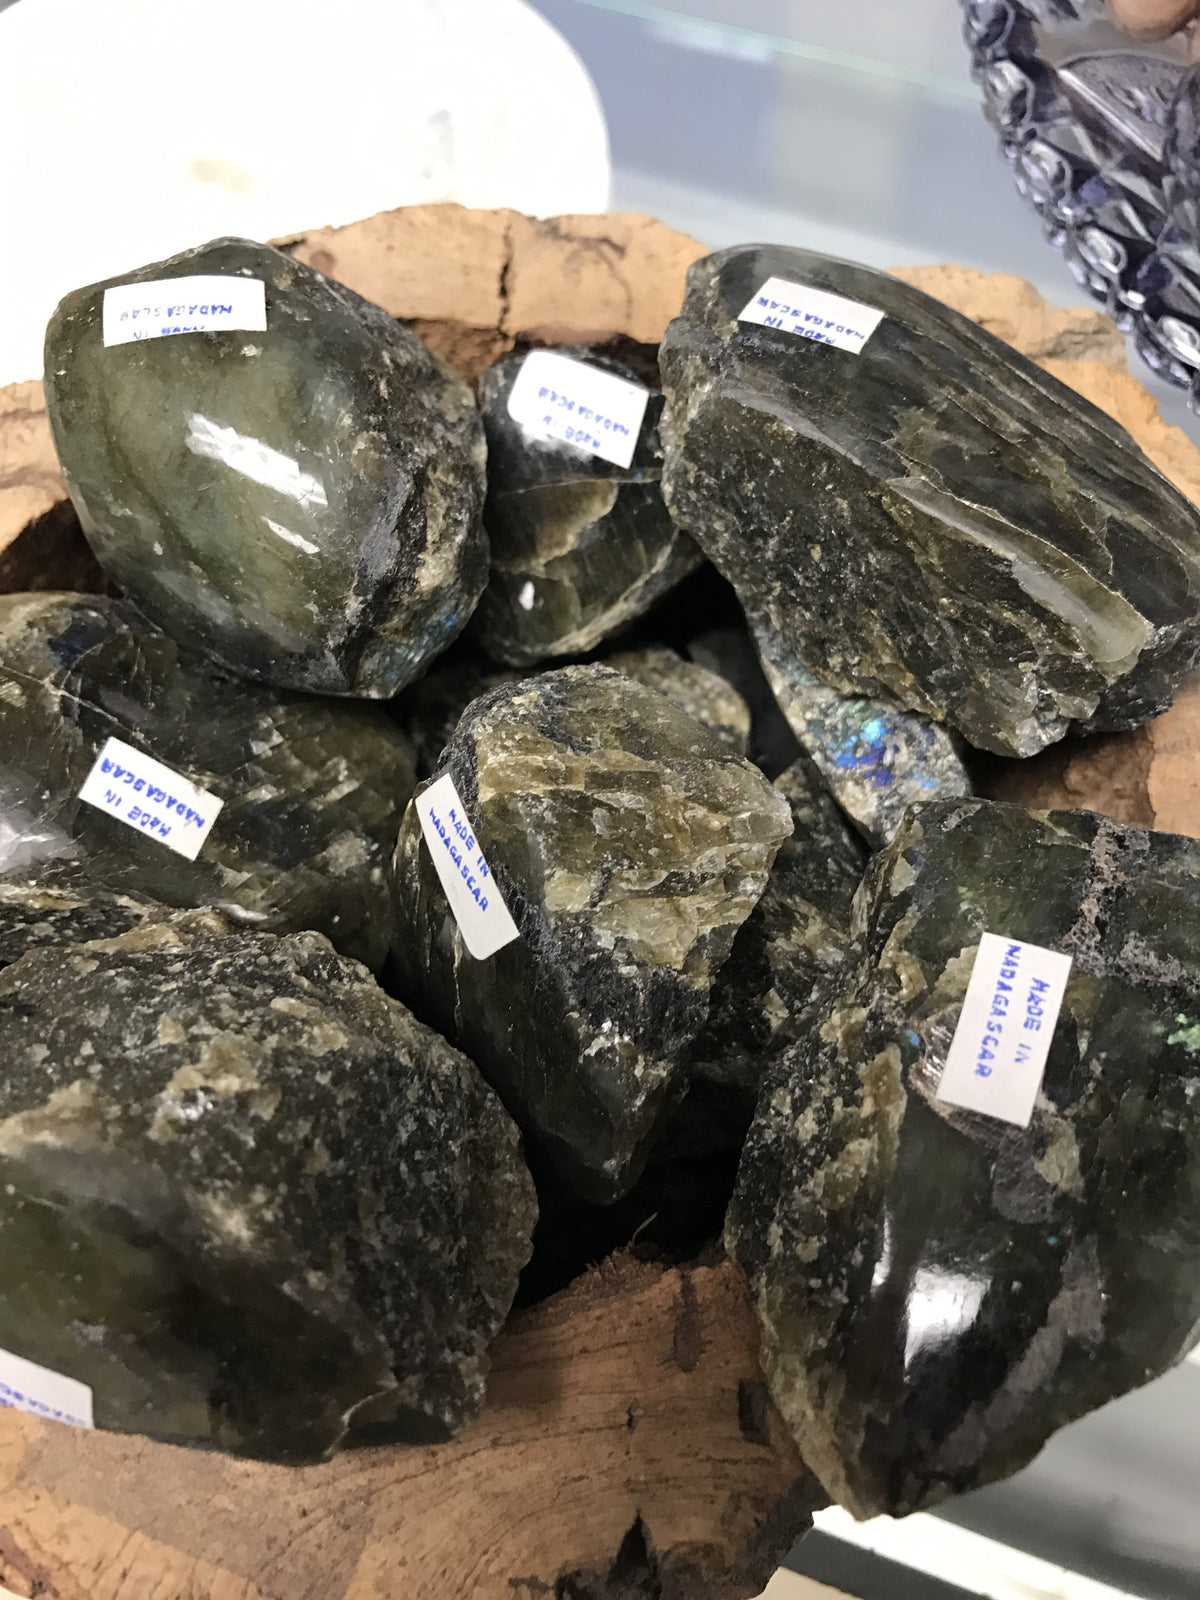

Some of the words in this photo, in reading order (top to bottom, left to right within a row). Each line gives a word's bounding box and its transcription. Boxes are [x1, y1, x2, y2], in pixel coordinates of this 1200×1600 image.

[756, 296, 865, 340] MADAGASCAR
[763, 315, 784, 329] IN
[792, 325, 836, 345] MADE
[100, 757, 206, 829] MADAGASCAR
[103, 789, 122, 808] IN
[127, 805, 172, 838] MADE
[448, 808, 475, 852] MADE
[476, 855, 490, 878] IN
[428, 806, 490, 912] MADAGASCAR
[973, 943, 1022, 1079] MADAGASCAR
[1022, 976, 1051, 1032] MADE
[1013, 1042, 1032, 1064] IN
